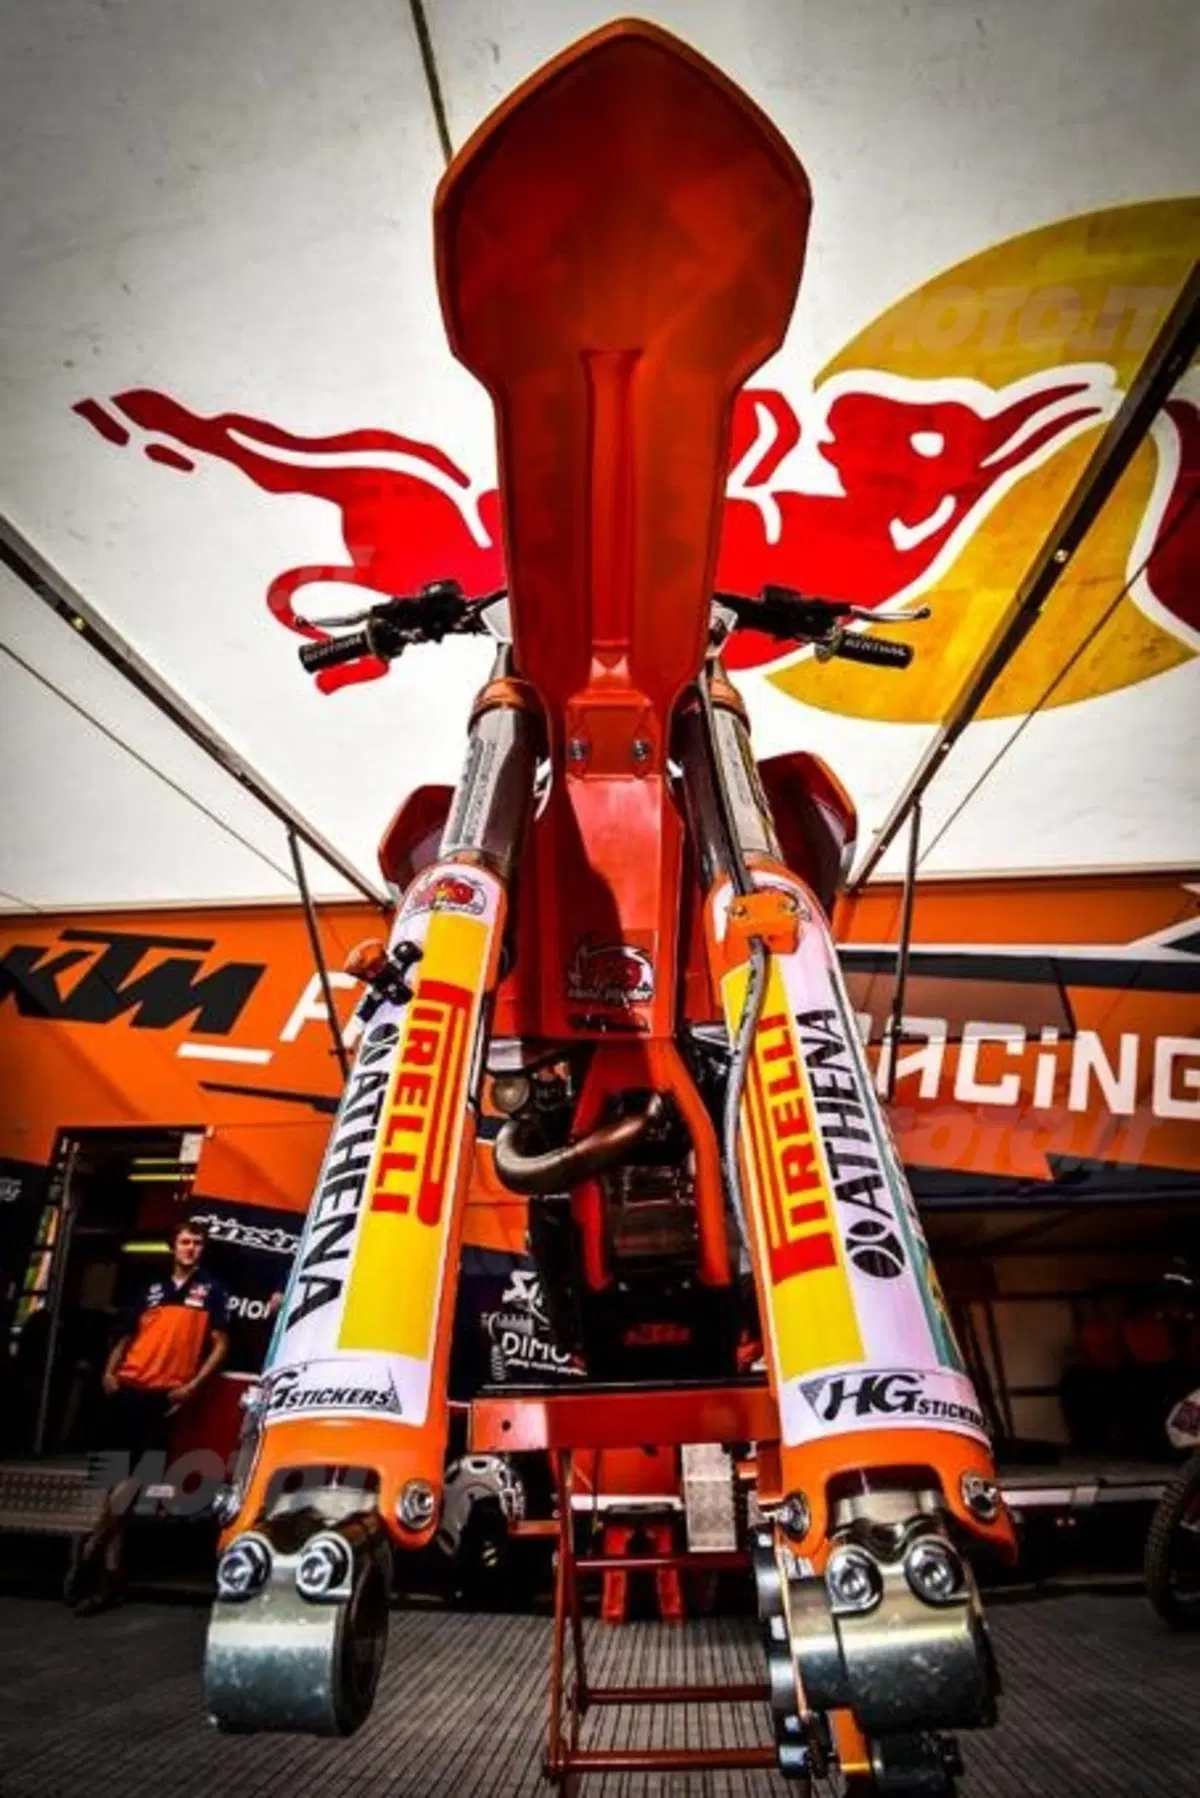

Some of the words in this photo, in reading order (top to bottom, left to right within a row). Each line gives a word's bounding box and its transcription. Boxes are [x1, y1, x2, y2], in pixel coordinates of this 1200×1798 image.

[0, 929, 267, 1036] KTM
[369, 979, 474, 1227] PIRELLI
[796, 1009, 894, 1220] ATHENA
[853, 1012, 1200, 1120] ACiNG
[285, 1071, 389, 1332] ATHENA
[749, 1013, 838, 1286] PIRELLI
[285, 1387, 388, 1408] STICKERS
[823, 1374, 923, 1421] HG
